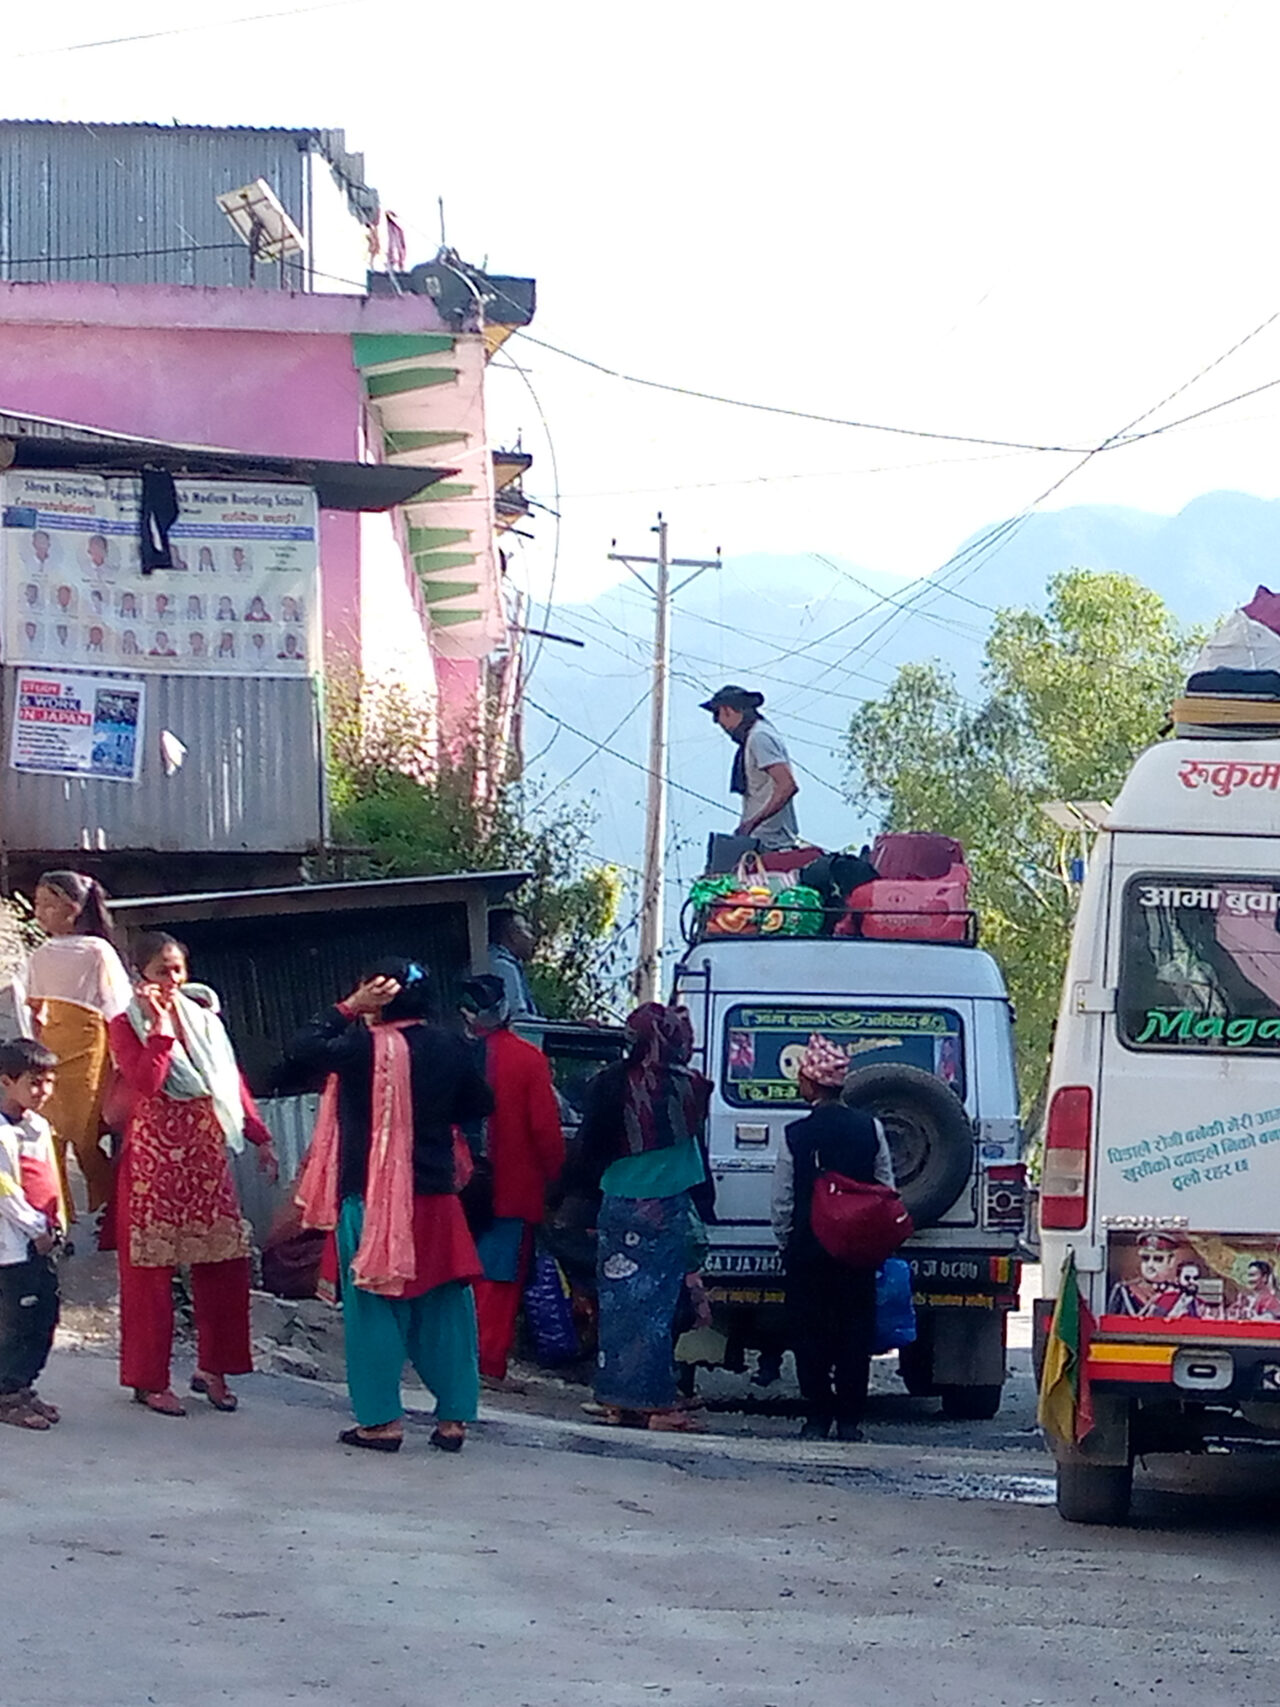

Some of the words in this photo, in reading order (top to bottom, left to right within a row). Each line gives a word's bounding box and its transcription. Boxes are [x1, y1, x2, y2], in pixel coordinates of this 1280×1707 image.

[20, 709, 36, 720] IN
[44, 711, 90, 725] JAPAN
[1138, 886, 1222, 910] आमा
